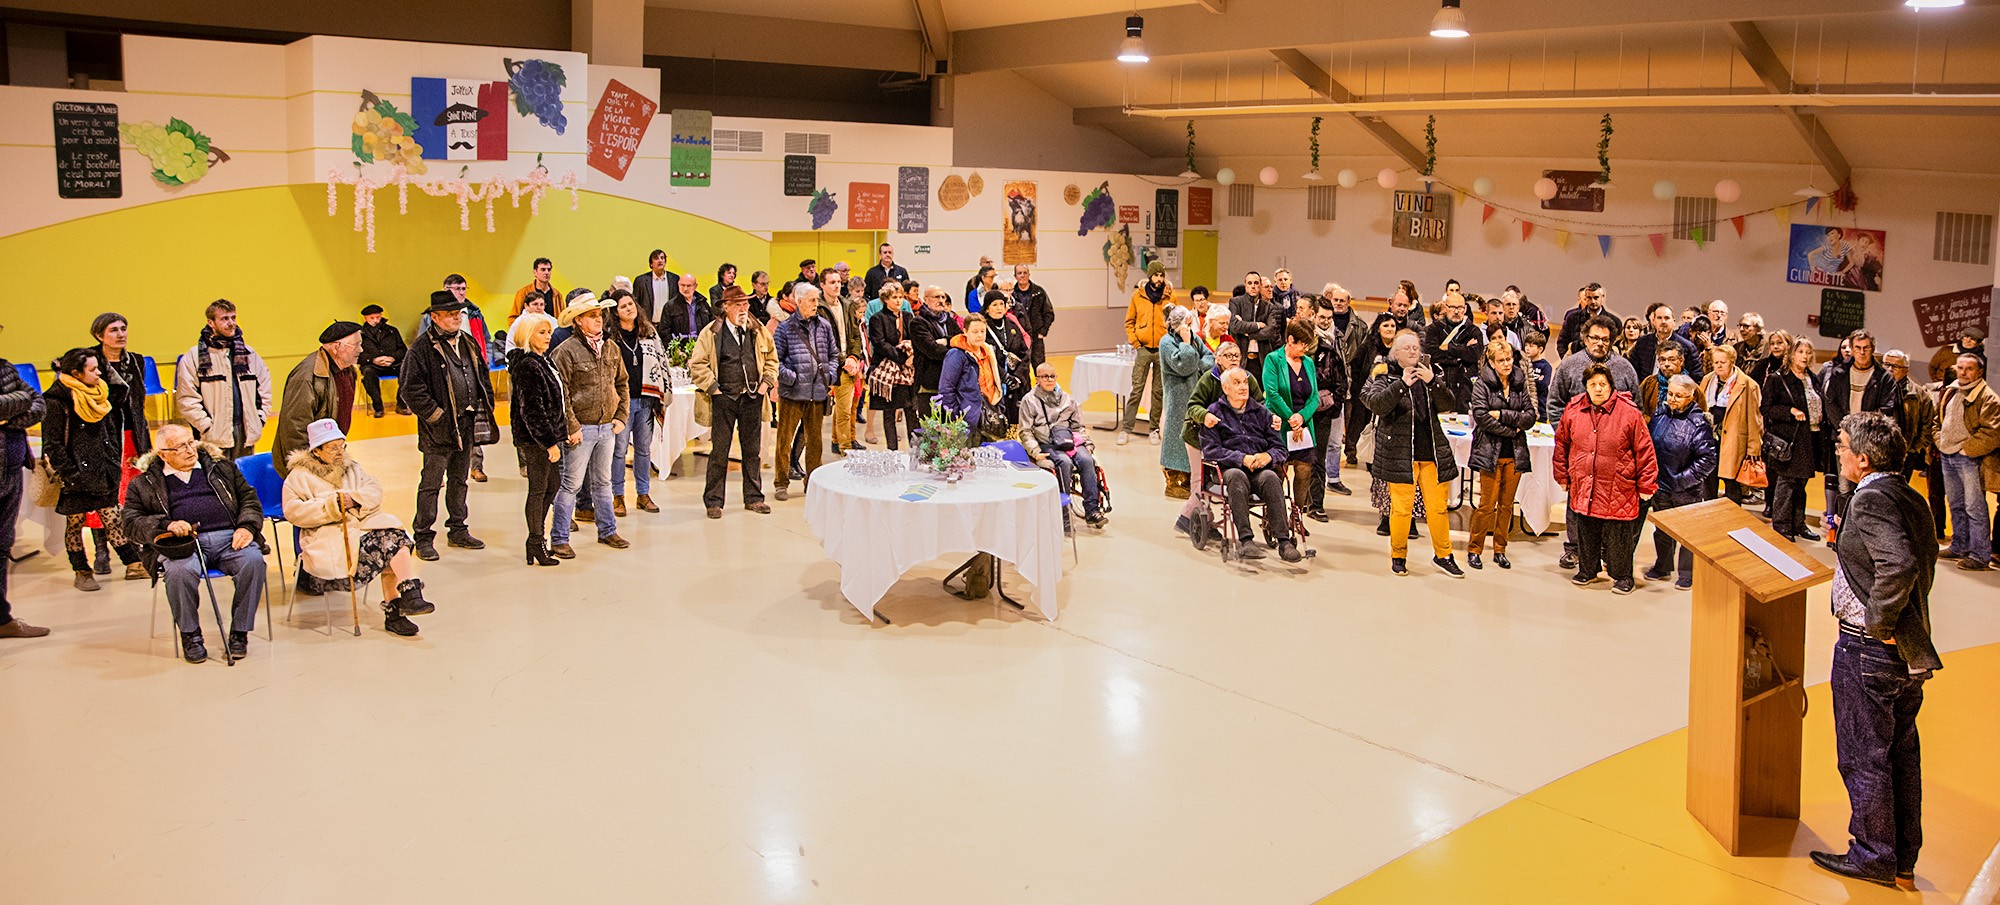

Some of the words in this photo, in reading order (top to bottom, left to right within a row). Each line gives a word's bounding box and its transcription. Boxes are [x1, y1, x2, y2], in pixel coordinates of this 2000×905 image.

[610, 90, 628, 99] TANT
[461, 110, 478, 121] MONT
[91, 119, 101, 127] de
[620, 126, 627, 134] A
[629, 127, 640, 136] DE
[87, 152, 108, 160] reste
[59, 160, 69, 168] de
[1395, 193, 1434, 213] VINO
[1409, 216, 1446, 239] BAR
[1790, 268, 1846, 286] GUINGUETTE
